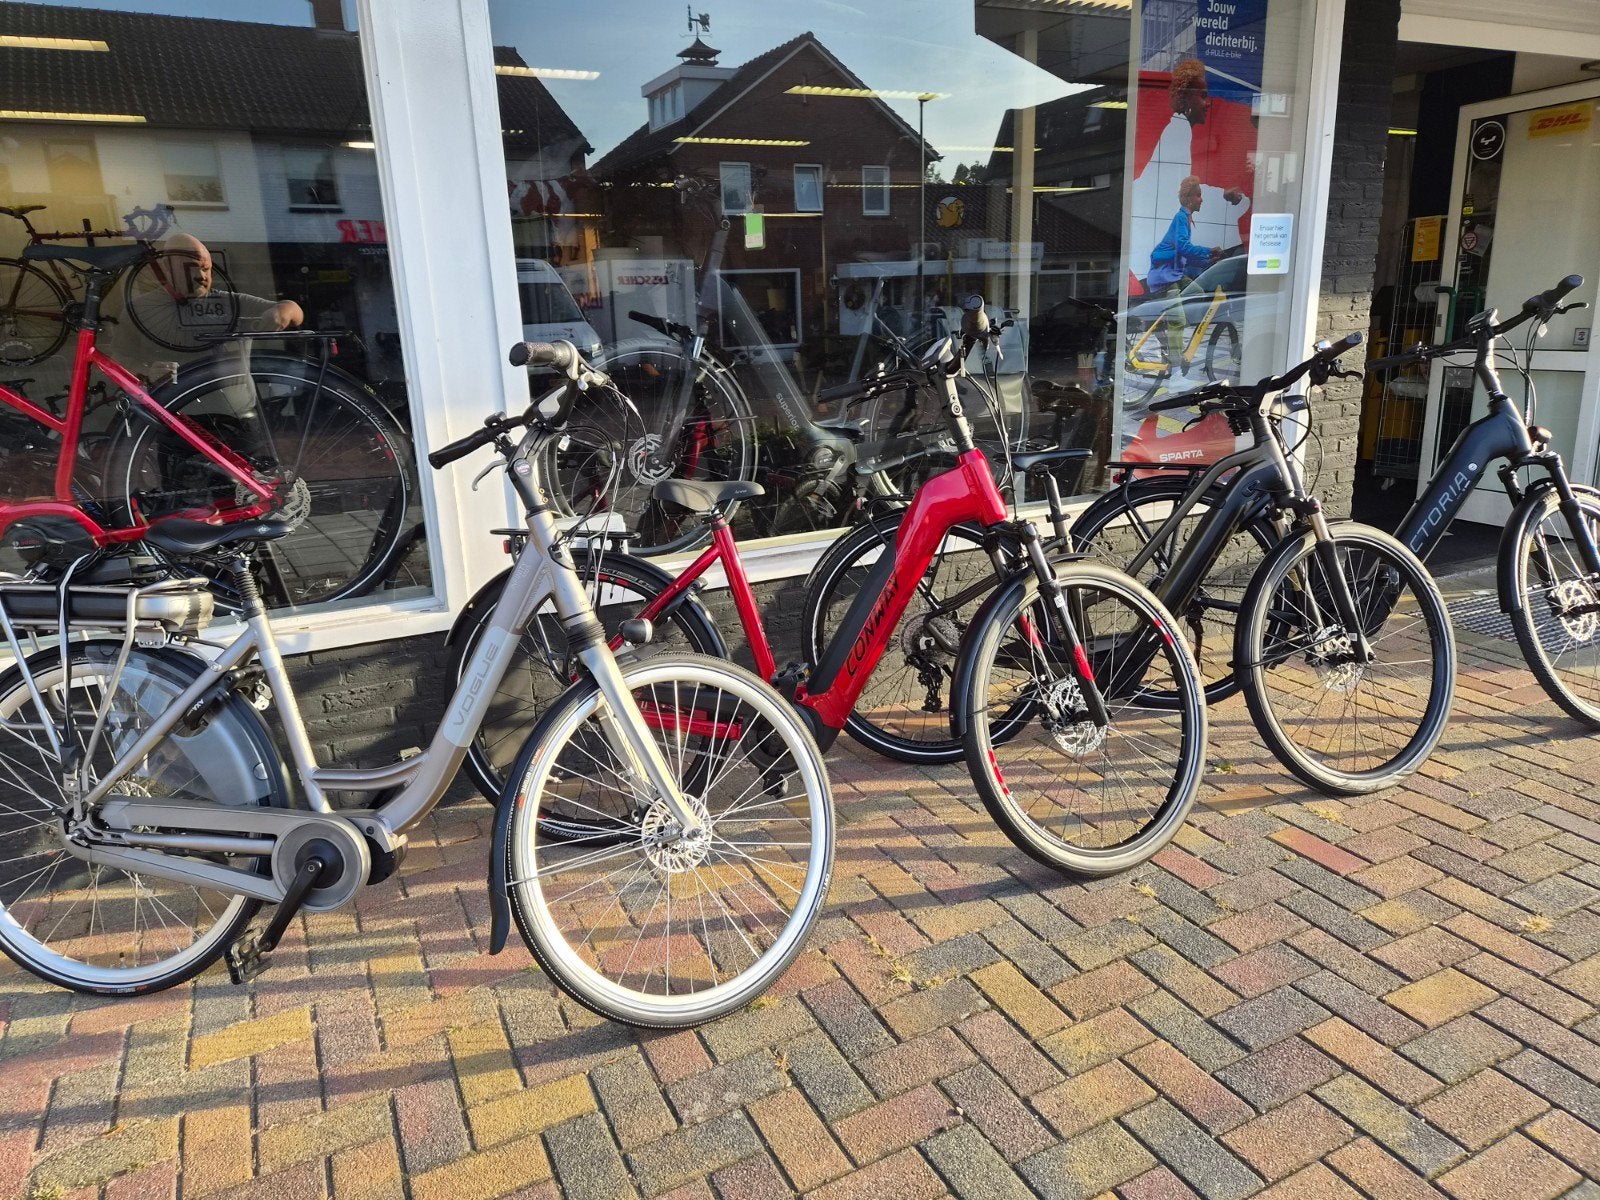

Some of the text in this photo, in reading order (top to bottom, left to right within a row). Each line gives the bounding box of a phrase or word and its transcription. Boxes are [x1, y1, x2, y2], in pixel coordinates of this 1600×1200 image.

[1207, 0, 1236, 15] Jouw
[1192, 16, 1229, 30] wereld
[1205, 32, 1258, 53] dichterbij.
[1536, 112, 1583, 130] DHL
[775, 392, 801, 432] superior
[1159, 449, 1204, 462] SPARTA
[1409, 471, 1468, 553] CTORIA
[845, 571, 899, 677] CONWAY
[453, 642, 499, 726] VOGUE
